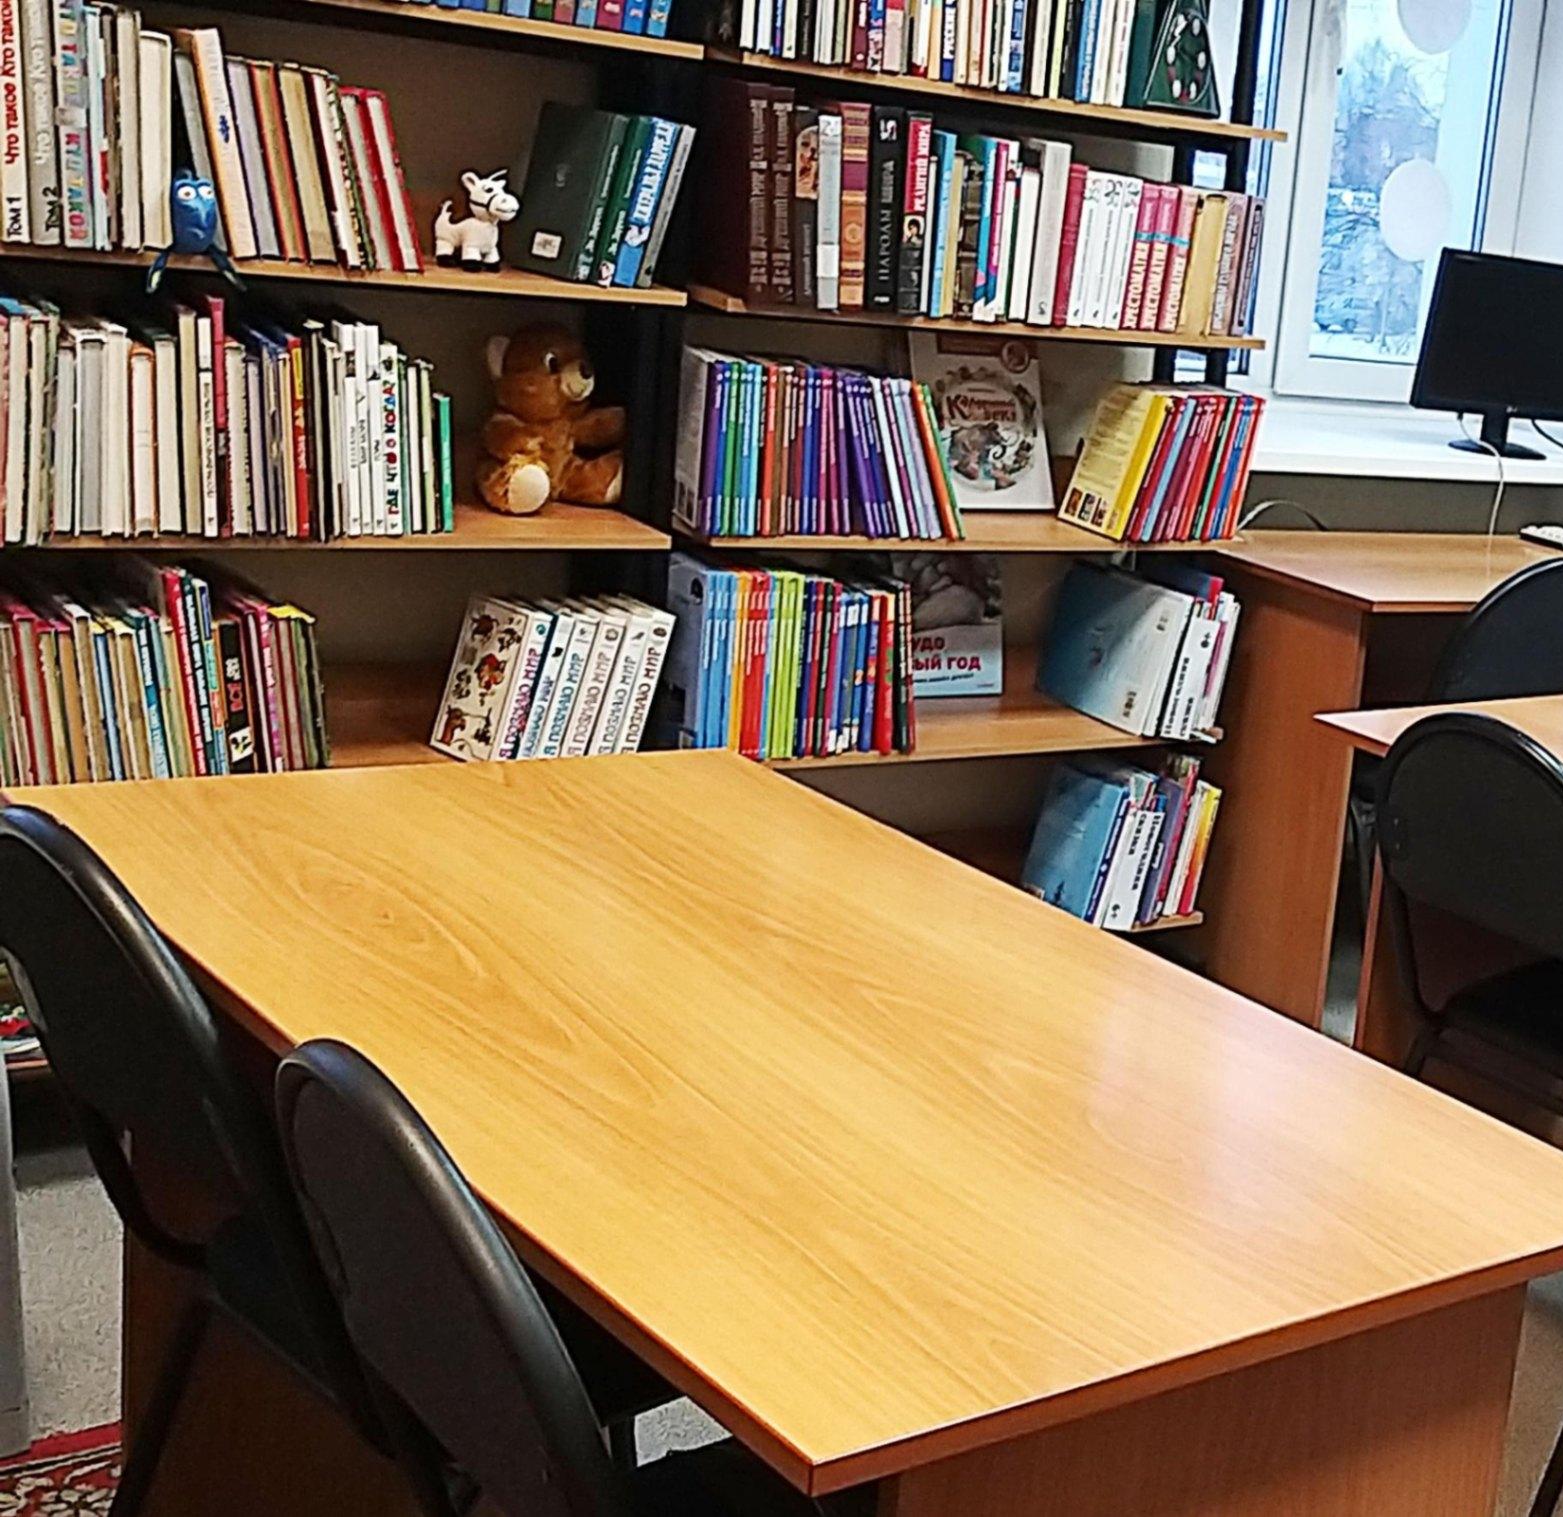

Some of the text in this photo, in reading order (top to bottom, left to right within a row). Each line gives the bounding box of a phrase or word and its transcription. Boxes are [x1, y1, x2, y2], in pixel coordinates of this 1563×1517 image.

[1, 48, 16, 79] Кто
[2, 83, 18, 129] такое
[4, 134, 20, 166] Что
[913, 637, 945, 653] УДО
[567, 653, 584, 683] МИР
[643, 647, 661, 679] МИР
[914, 654, 981, 672] ЫЙ ГОД
